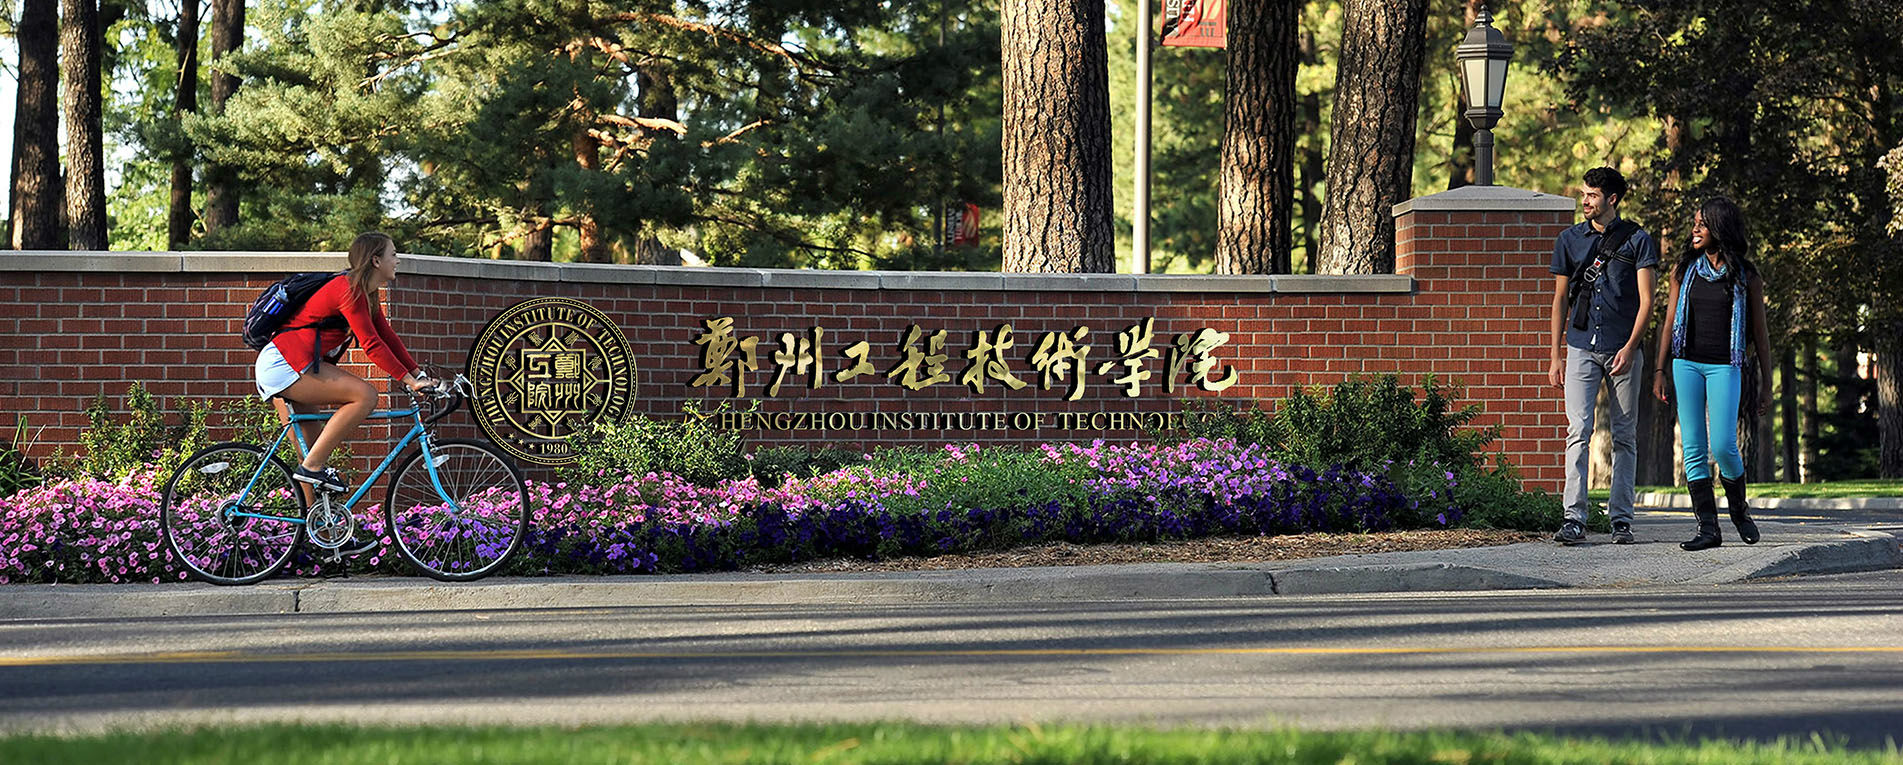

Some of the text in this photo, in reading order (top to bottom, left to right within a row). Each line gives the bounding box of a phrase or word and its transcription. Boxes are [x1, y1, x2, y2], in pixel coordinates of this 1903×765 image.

[480, 306, 629, 427] ZHENGZHOU INSTITUTE OF TECHNOLOG
[705, 412, 864, 431] HENGZHOU
[872, 412, 1008, 431] INSTITUTE
[1014, 412, 1046, 431] OF
[540, 443, 568, 455] 1980
